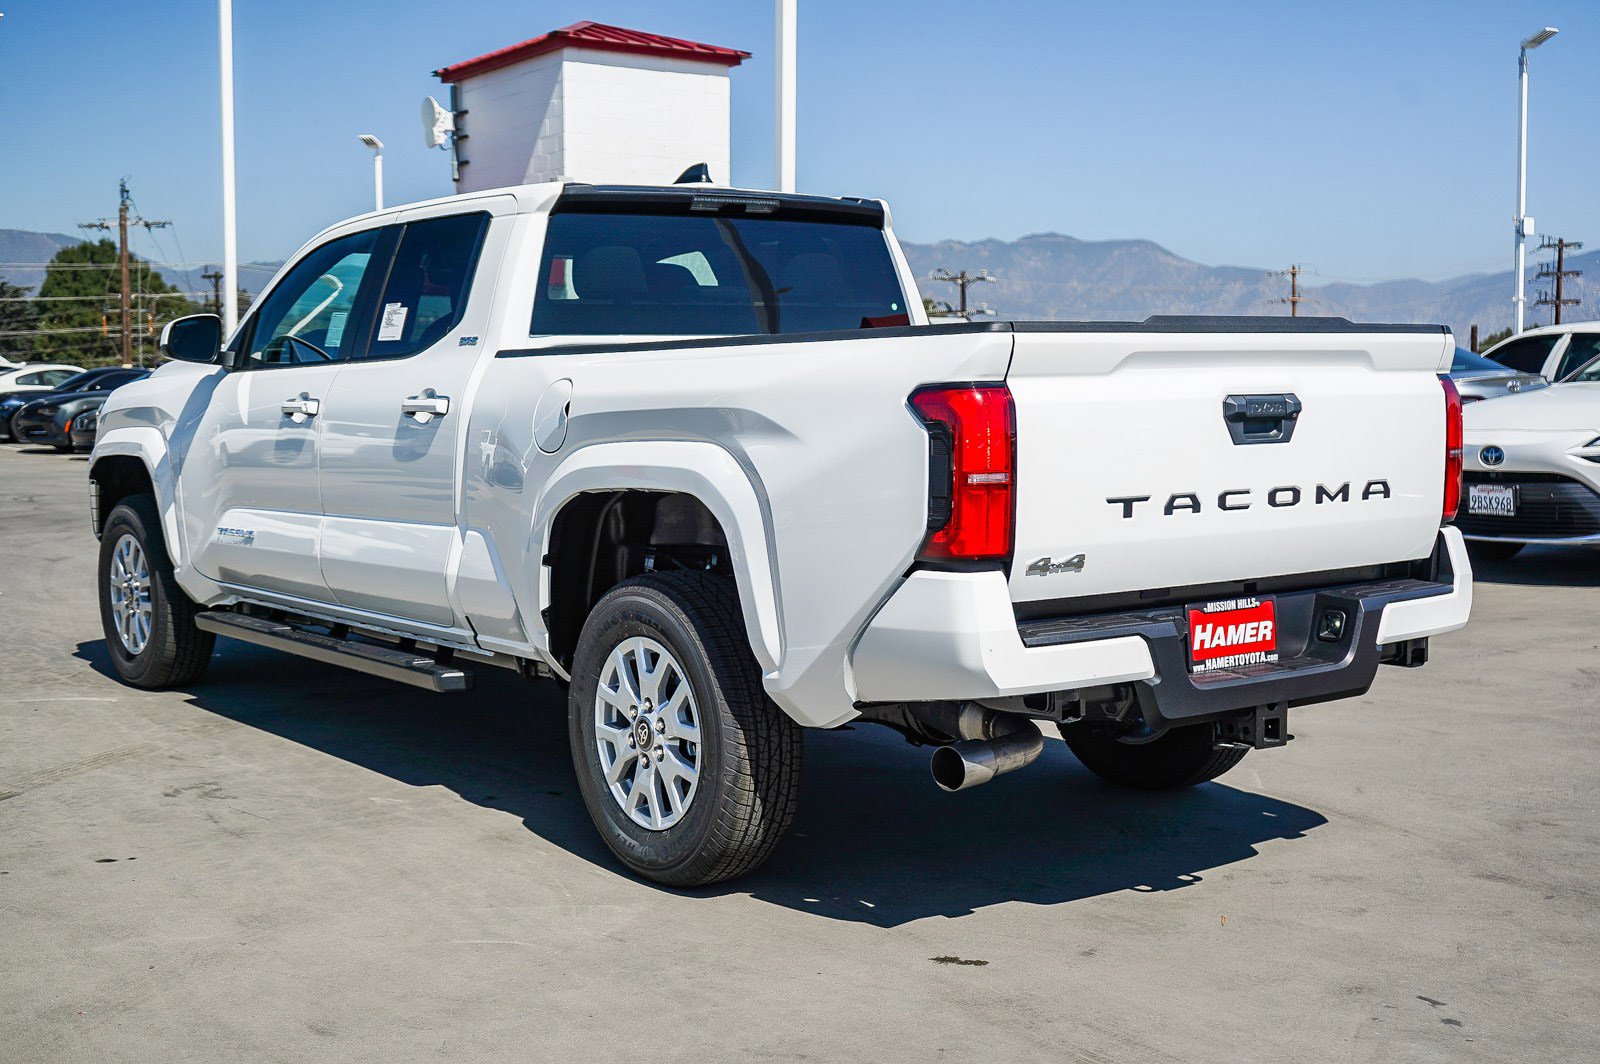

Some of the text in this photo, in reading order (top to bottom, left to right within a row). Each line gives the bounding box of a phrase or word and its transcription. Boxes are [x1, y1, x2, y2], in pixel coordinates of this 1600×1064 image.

[1248, 402, 1284, 414] TOYOTA
[1106, 478, 1391, 518] TACOMA
[1206, 597, 1256, 613] MISSION HILLS
[1193, 620, 1273, 651] HAMER
[1193, 651, 1279, 673] www.HAMERTOYOTA.com
